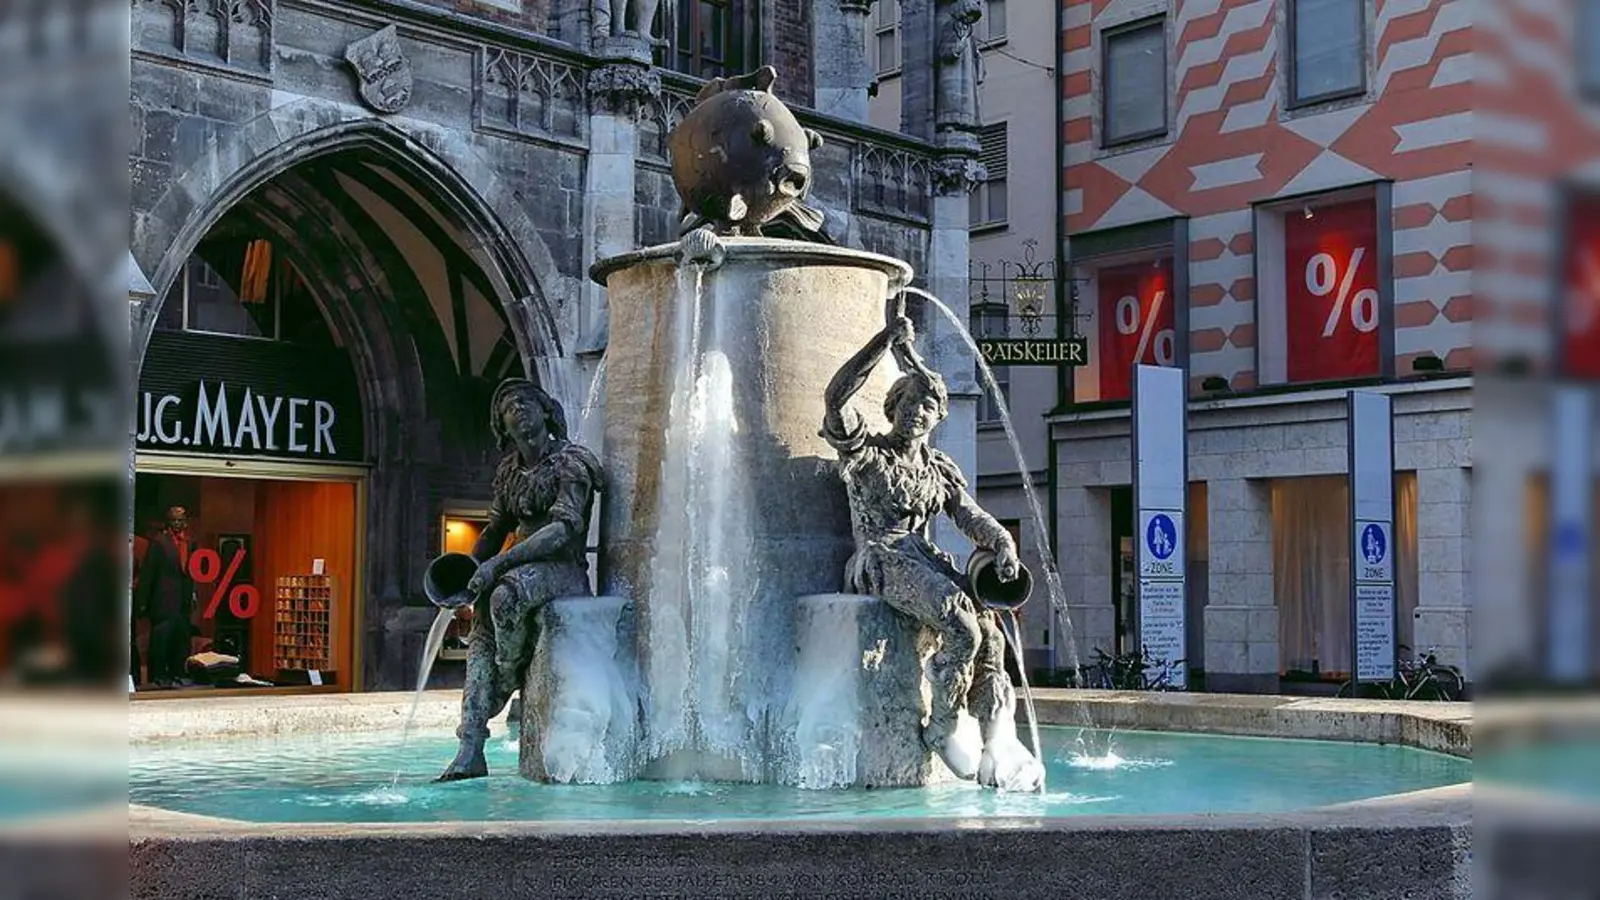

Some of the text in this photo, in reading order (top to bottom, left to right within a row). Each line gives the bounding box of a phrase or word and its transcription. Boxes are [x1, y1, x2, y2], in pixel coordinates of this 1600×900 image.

[1116, 291, 1174, 366] %
[1305, 248, 1379, 337] %
[981, 341, 1081, 361] RATSKELLER
[192, 379, 336, 454] MAYER
[189, 547, 260, 619] %
[1151, 562, 1173, 574] ZONE
[1364, 567, 1383, 578] ZONE
